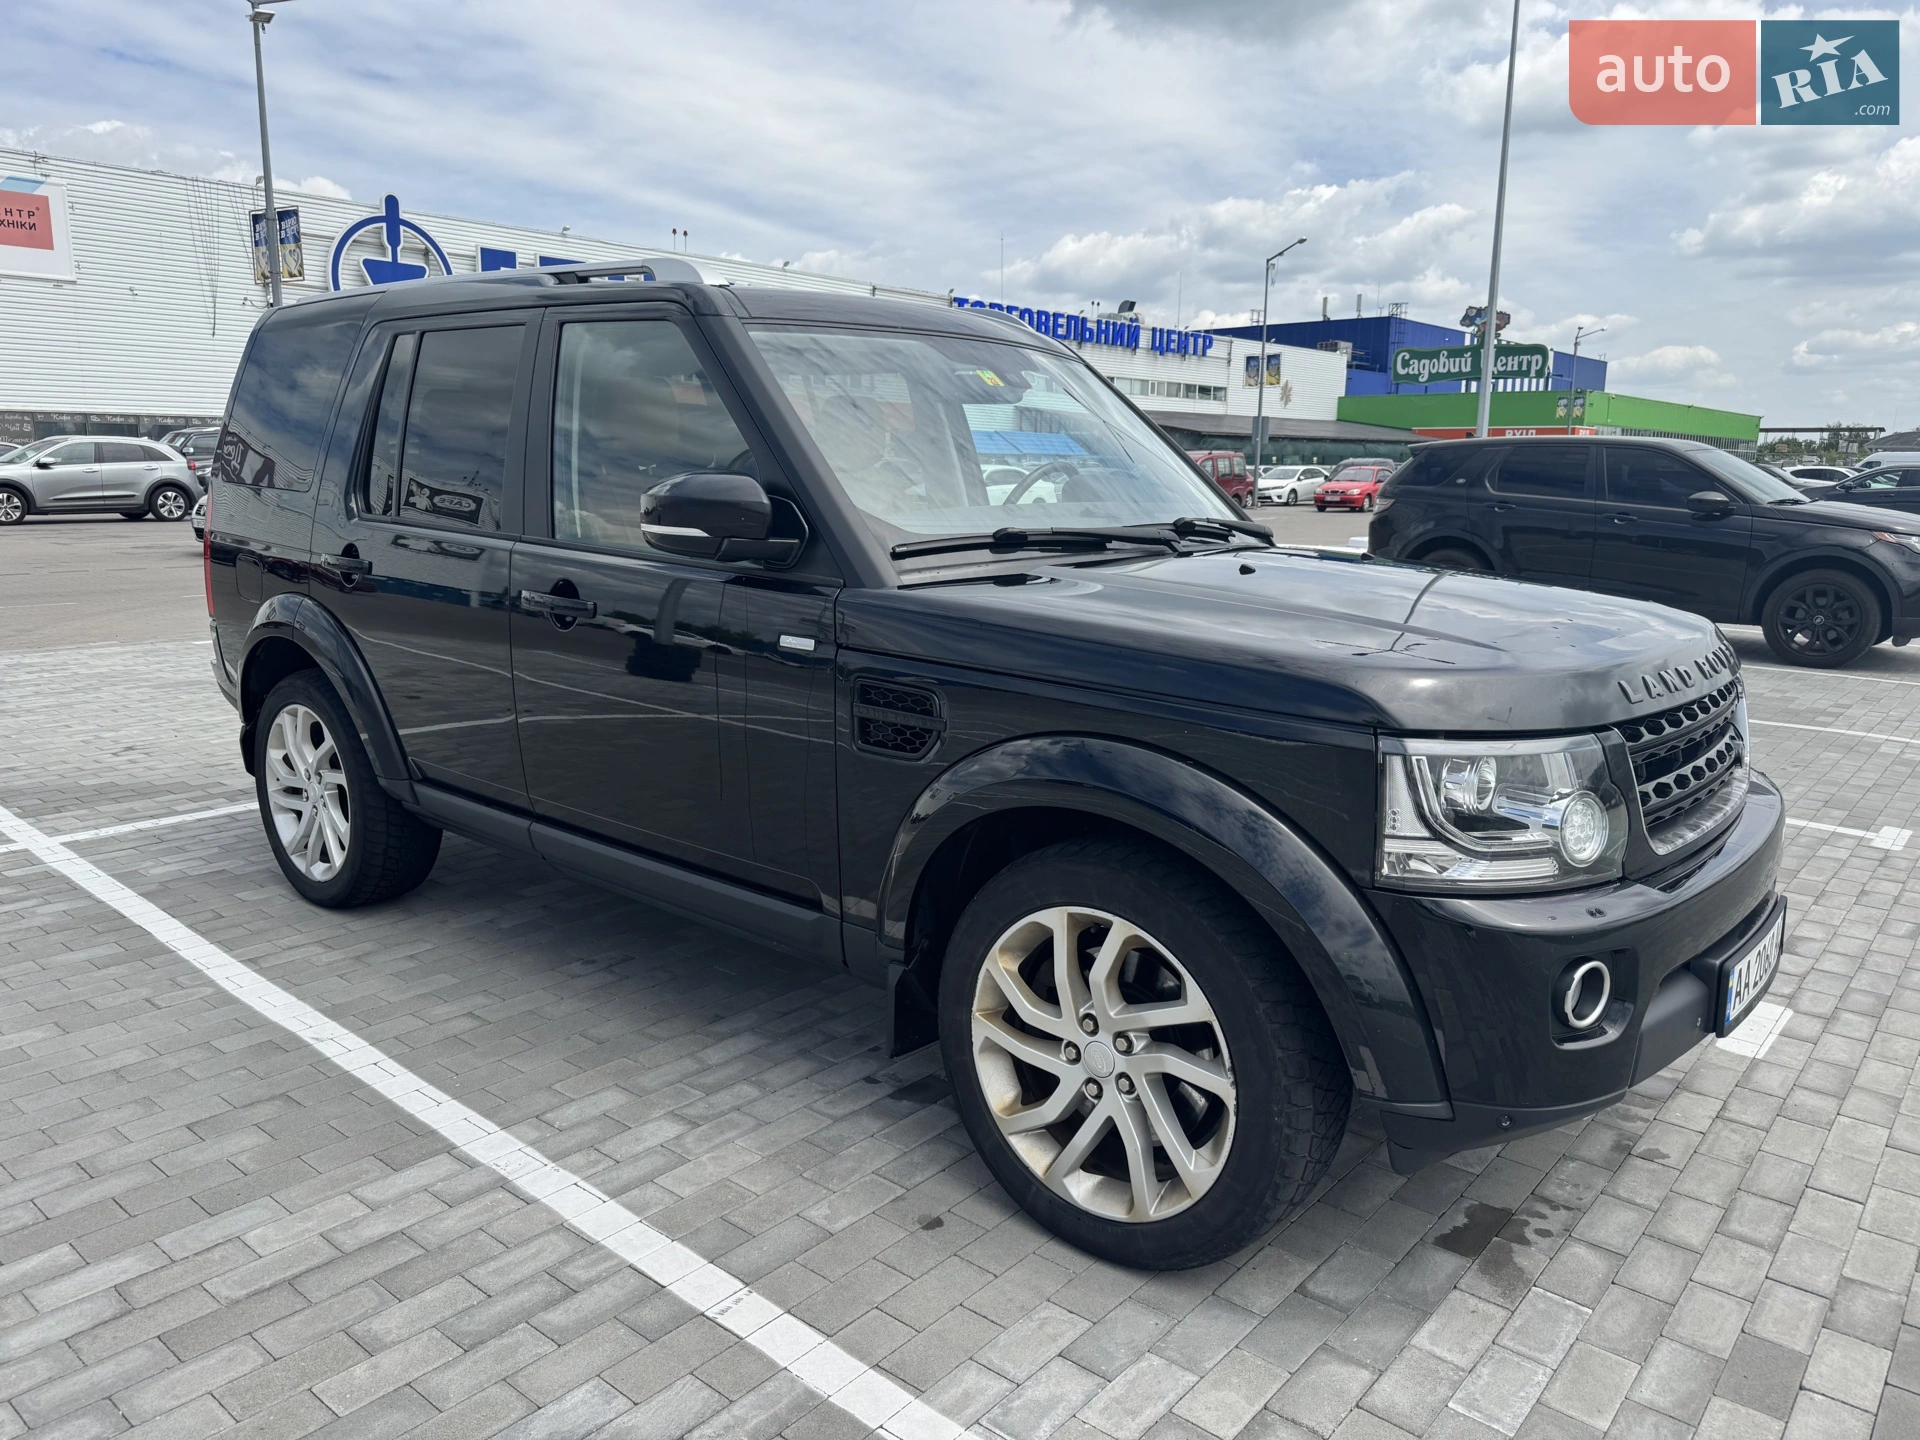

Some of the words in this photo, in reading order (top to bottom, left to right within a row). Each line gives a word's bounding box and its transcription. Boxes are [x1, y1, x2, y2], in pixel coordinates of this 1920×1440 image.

[1151, 326, 1214, 357] ЦЕНТР
[1396, 350, 1472, 383] Садовий
[1480, 349, 1543, 378] ентр
[1617, 665, 1695, 704] LAND
